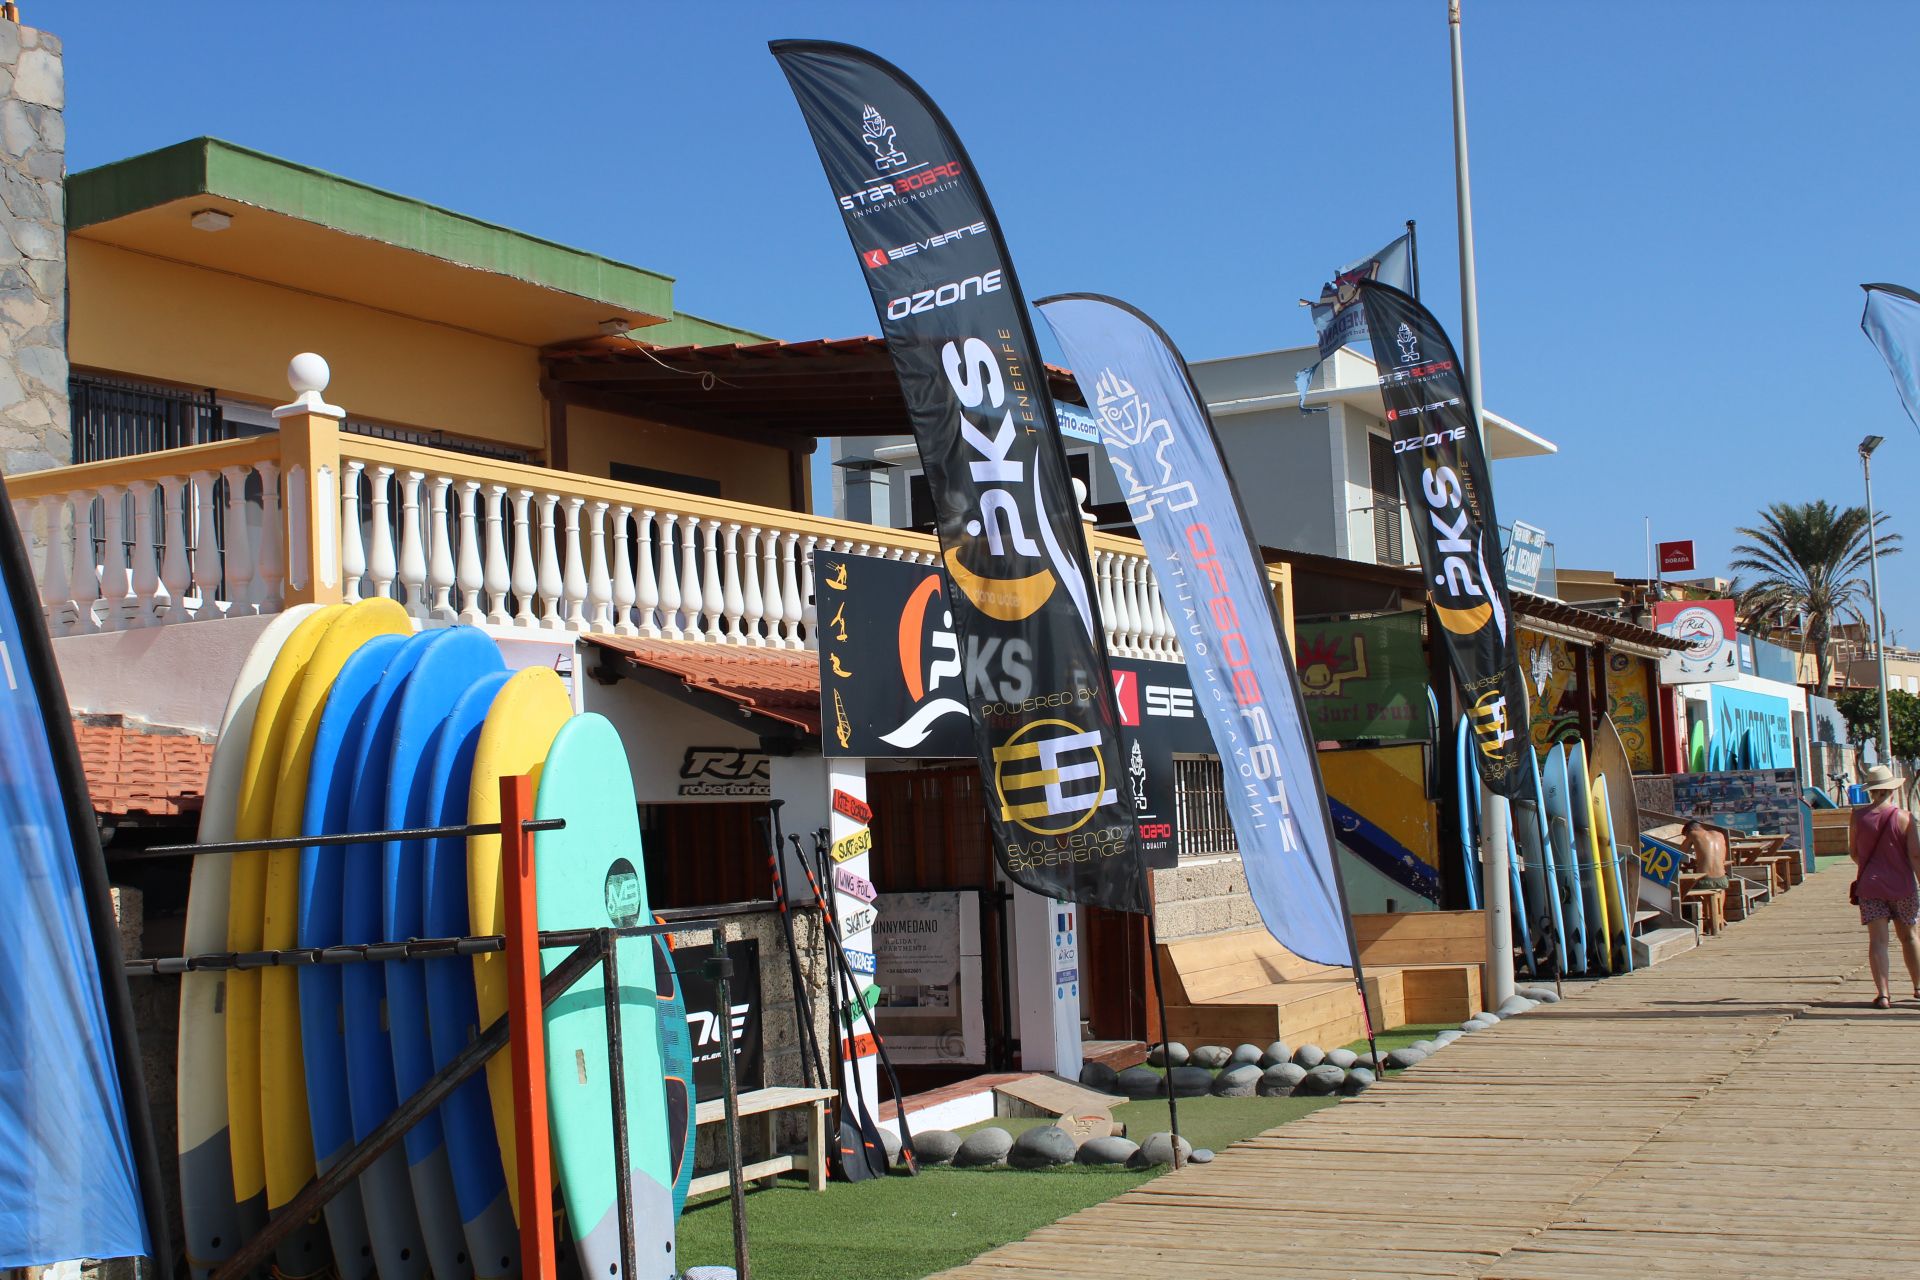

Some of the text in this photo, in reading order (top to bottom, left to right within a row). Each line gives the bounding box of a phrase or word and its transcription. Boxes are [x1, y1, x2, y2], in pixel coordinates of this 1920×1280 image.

[853, 180, 959, 219] INNOVATION QUALITY
[888, 221, 986, 261] SEVERNE
[887, 269, 1001, 320] OZONE
[998, 328, 1037, 436] TENERIFE
[1399, 398, 1460, 417] SEVERNE
[1393, 426, 1466, 454] OZONE
[1460, 460, 1482, 525] TENERIFE
[982, 686, 1098, 719] POWERED BY
[1008, 827, 1123, 858] EVOLVENDO
[1008, 841, 1126, 872] EXPERIENCE
[1146, 841, 1167, 850] QUALITY
[1640, 842, 1672, 880] AR
[845, 909, 870, 934] SKATE
[874, 919, 938, 934] UNNYMEDANO
[846, 950, 875, 973] STORAGE
